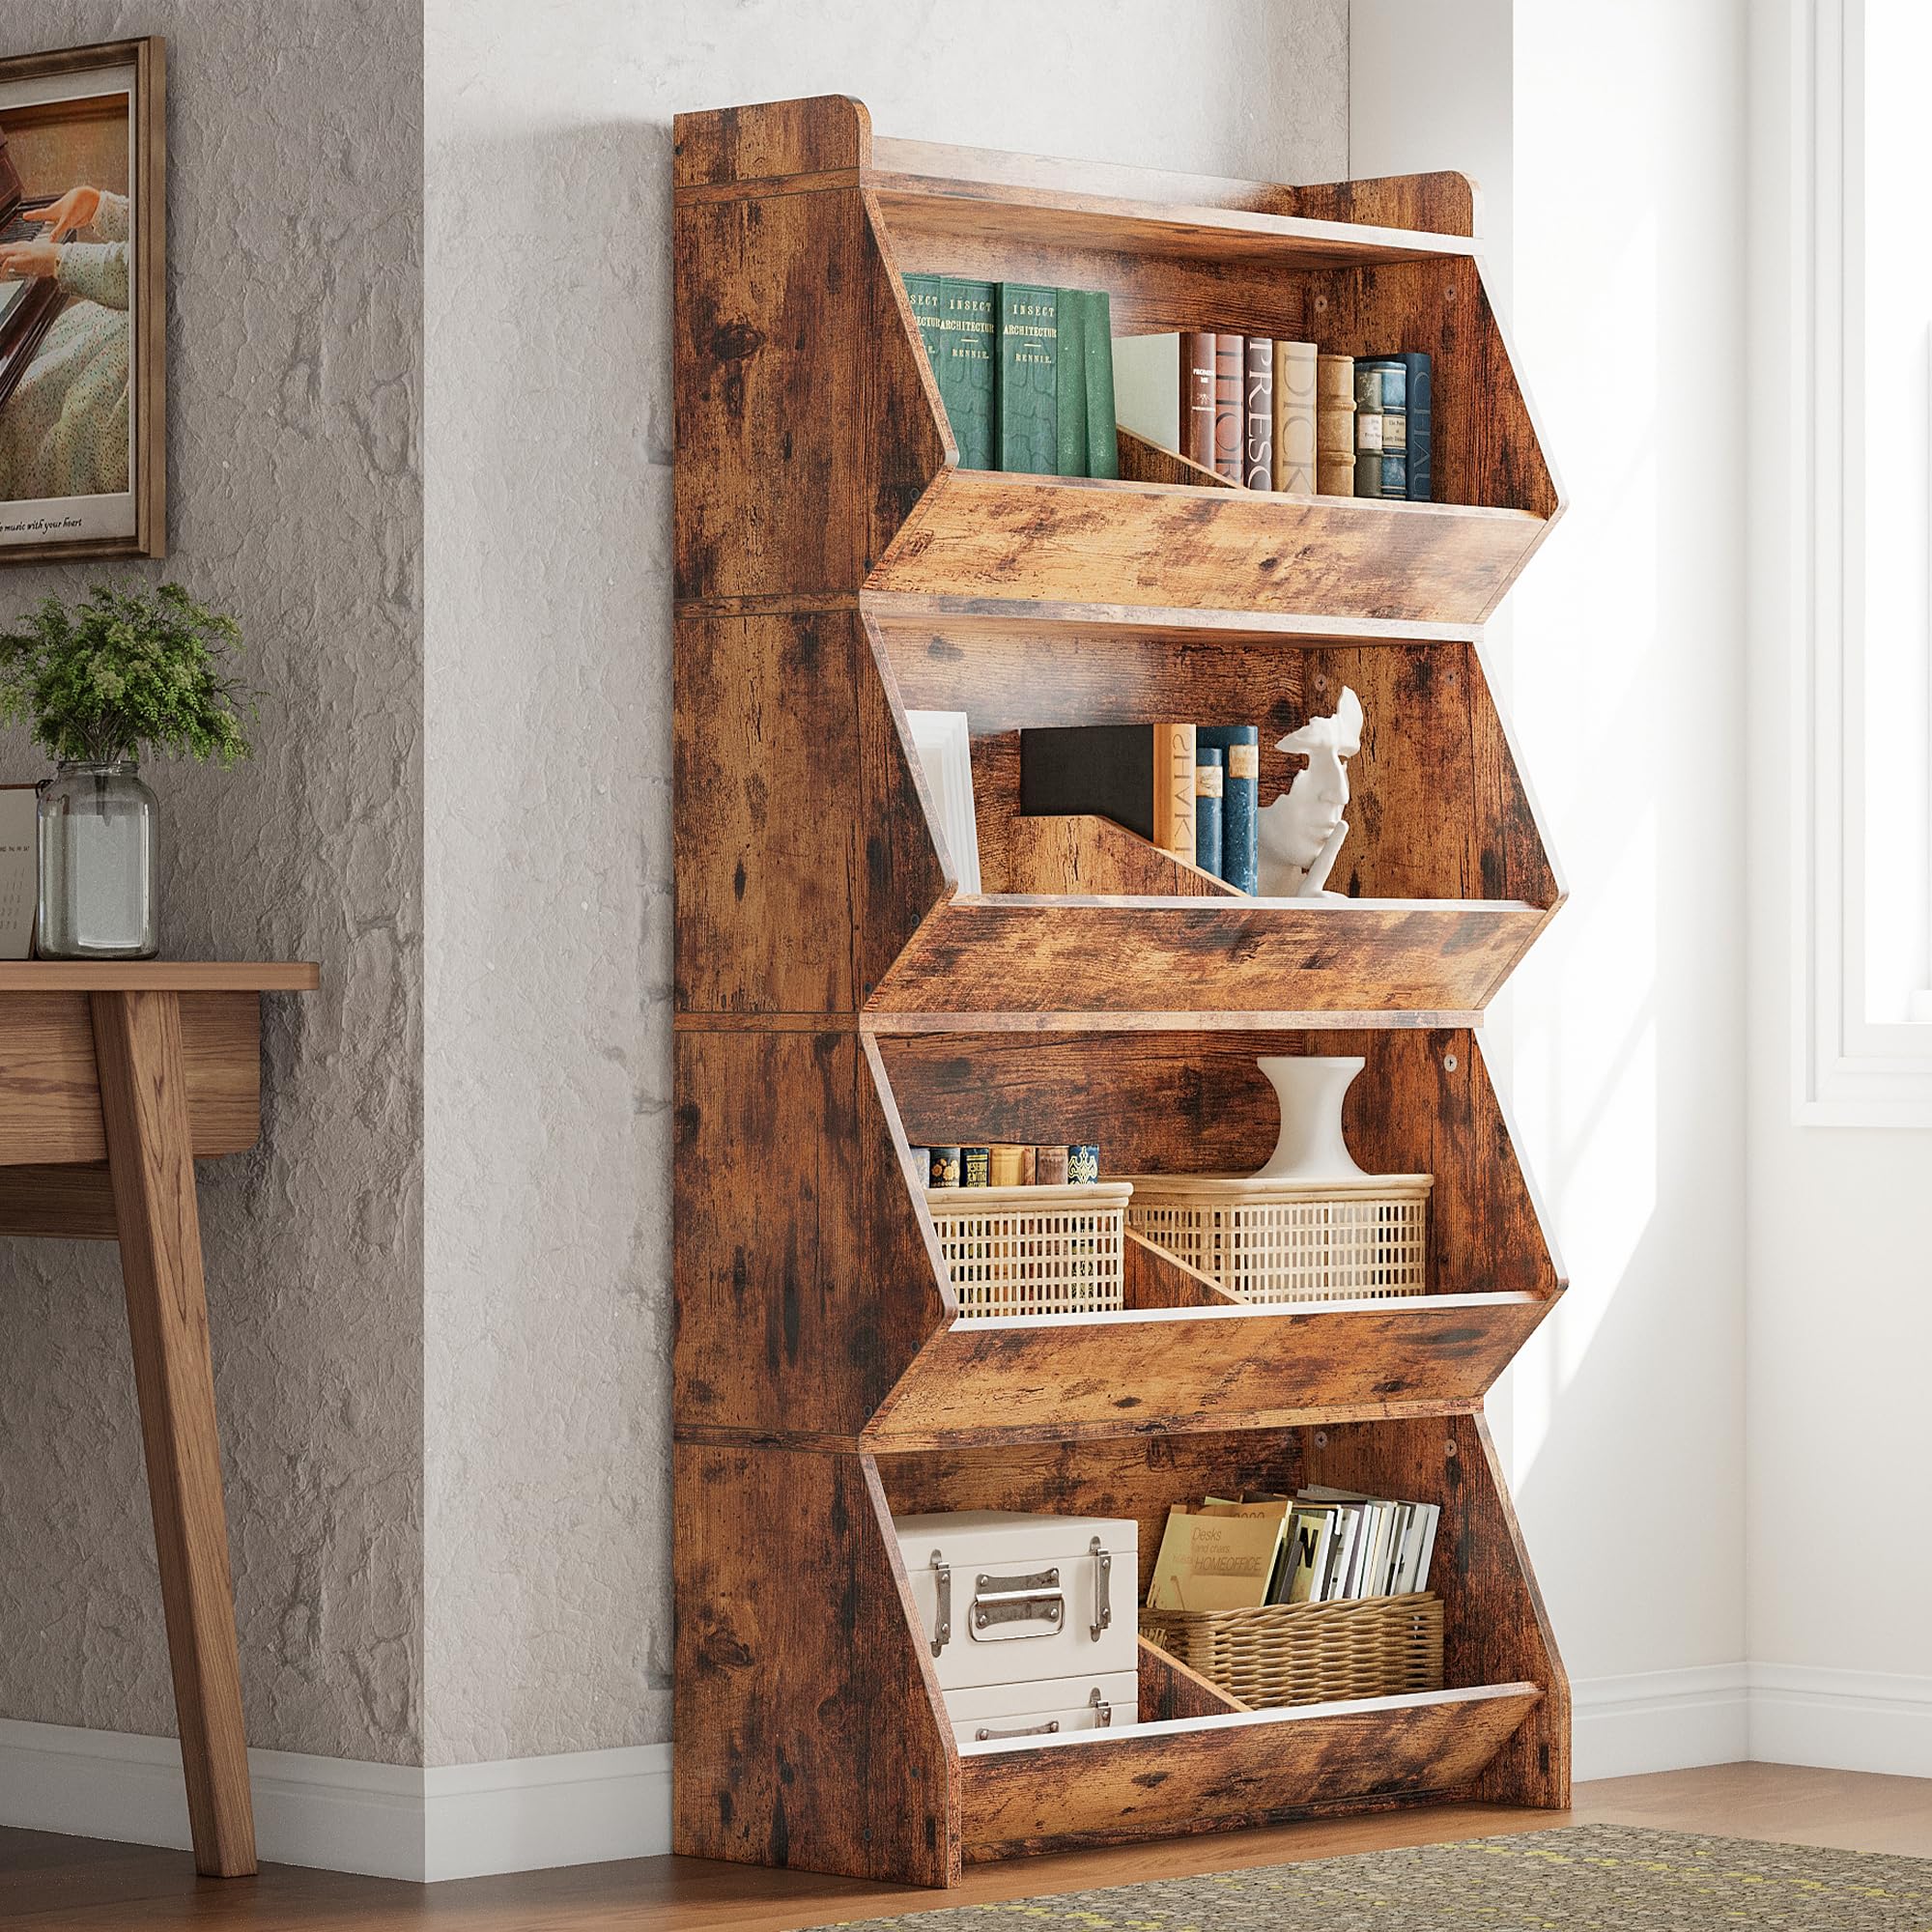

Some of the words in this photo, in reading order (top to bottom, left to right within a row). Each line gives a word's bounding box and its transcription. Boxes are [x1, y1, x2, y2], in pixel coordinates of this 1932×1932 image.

[950, 298, 991, 312] INSECT
[1013, 303, 1054, 317] INSECT
[940, 320, 994, 333] ARCHITECTUR
[1003, 324, 1057, 338] ARCHITECTUR
[1015, 353, 1052, 364] RENNIE.
[1282, 354, 1315, 494] DICK
[4, 522, 26, 531] music
[43, 522, 62, 534] your
[1192, 1527, 1222, 1541] Desks
